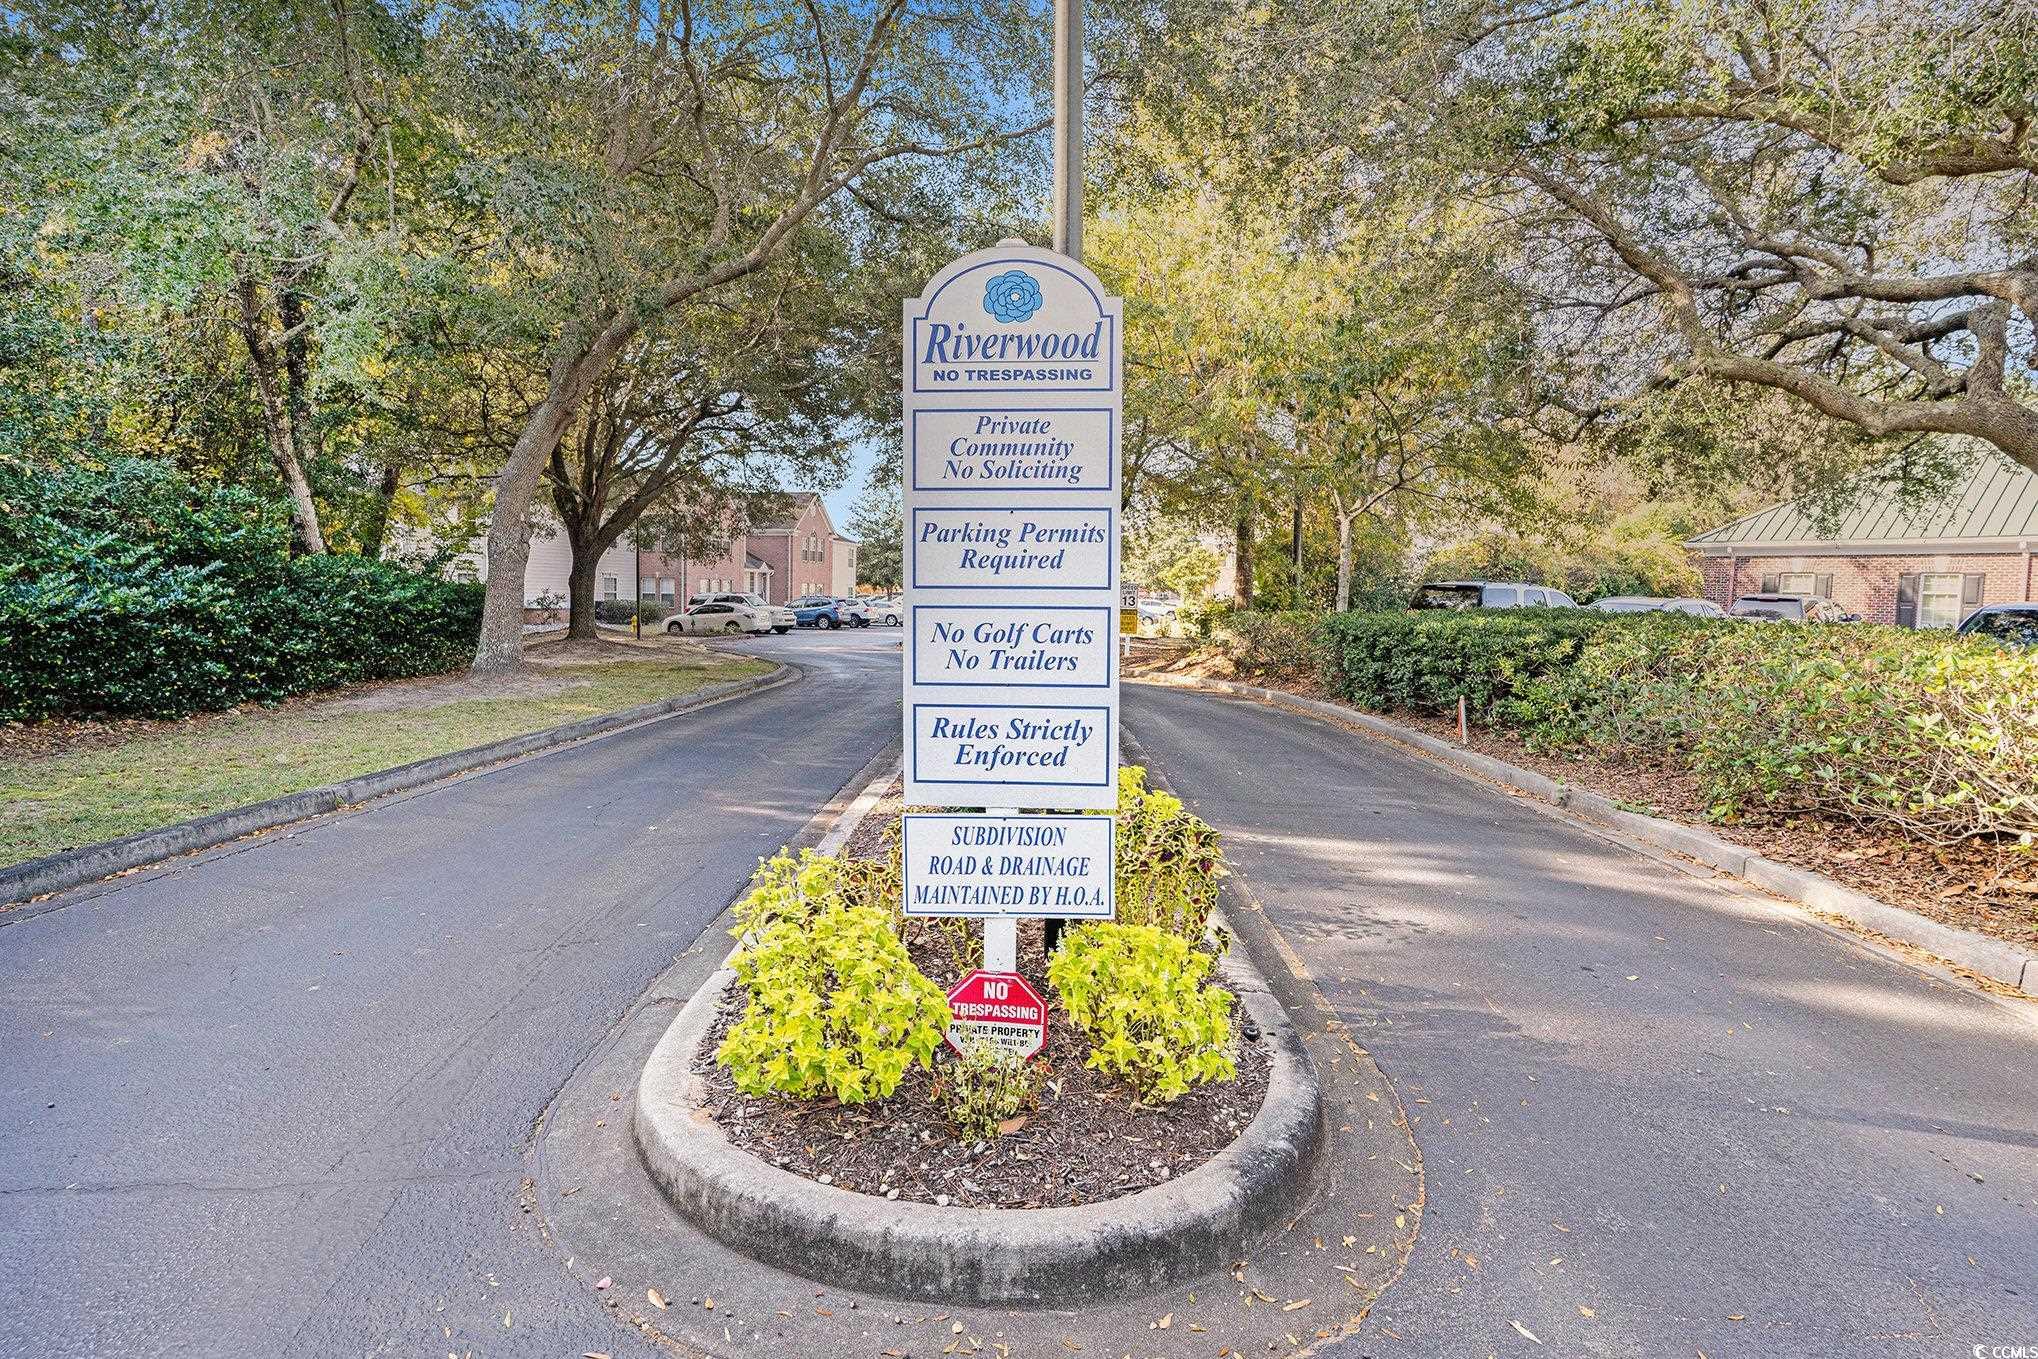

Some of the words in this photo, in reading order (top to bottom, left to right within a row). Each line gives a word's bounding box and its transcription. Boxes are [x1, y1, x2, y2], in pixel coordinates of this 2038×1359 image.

[922, 322, 1103, 363] Riverwood
[933, 369, 959, 381] NO
[965, 368, 1093, 382] TRESPASSING
[975, 416, 1051, 434] Private
[950, 437, 1075, 461] Community
[943, 460, 973, 480] No
[979, 459, 1083, 484] Soliciting
[920, 523, 1011, 548] Parking
[1020, 523, 1106, 544] Permits
[960, 549, 1064, 575] Required
[1122, 596, 1136, 606] 13
[930, 622, 965, 644] No
[973, 623, 1028, 648] Golf
[1032, 623, 1094, 645] Carts
[944, 649, 979, 670] No
[988, 650, 1079, 672] Trailers
[931, 717, 999, 740] Rules
[1005, 717, 1093, 747] Strictly
[955, 744, 1068, 771] Enforced
[951, 826, 1067, 847] SUBDIVISION
[928, 855, 977, 876] ROAD
[981, 855, 994, 876] &
[999, 856, 1091, 877] DRAINAGE
[912, 885, 1024, 905] MAINTAINED
[1027, 886, 1052, 906] BY
[1055, 887, 1105, 907] H.O.A.
[984, 982, 1008, 1000] NO
[953, 1002, 1038, 1019] TRESPASSING
